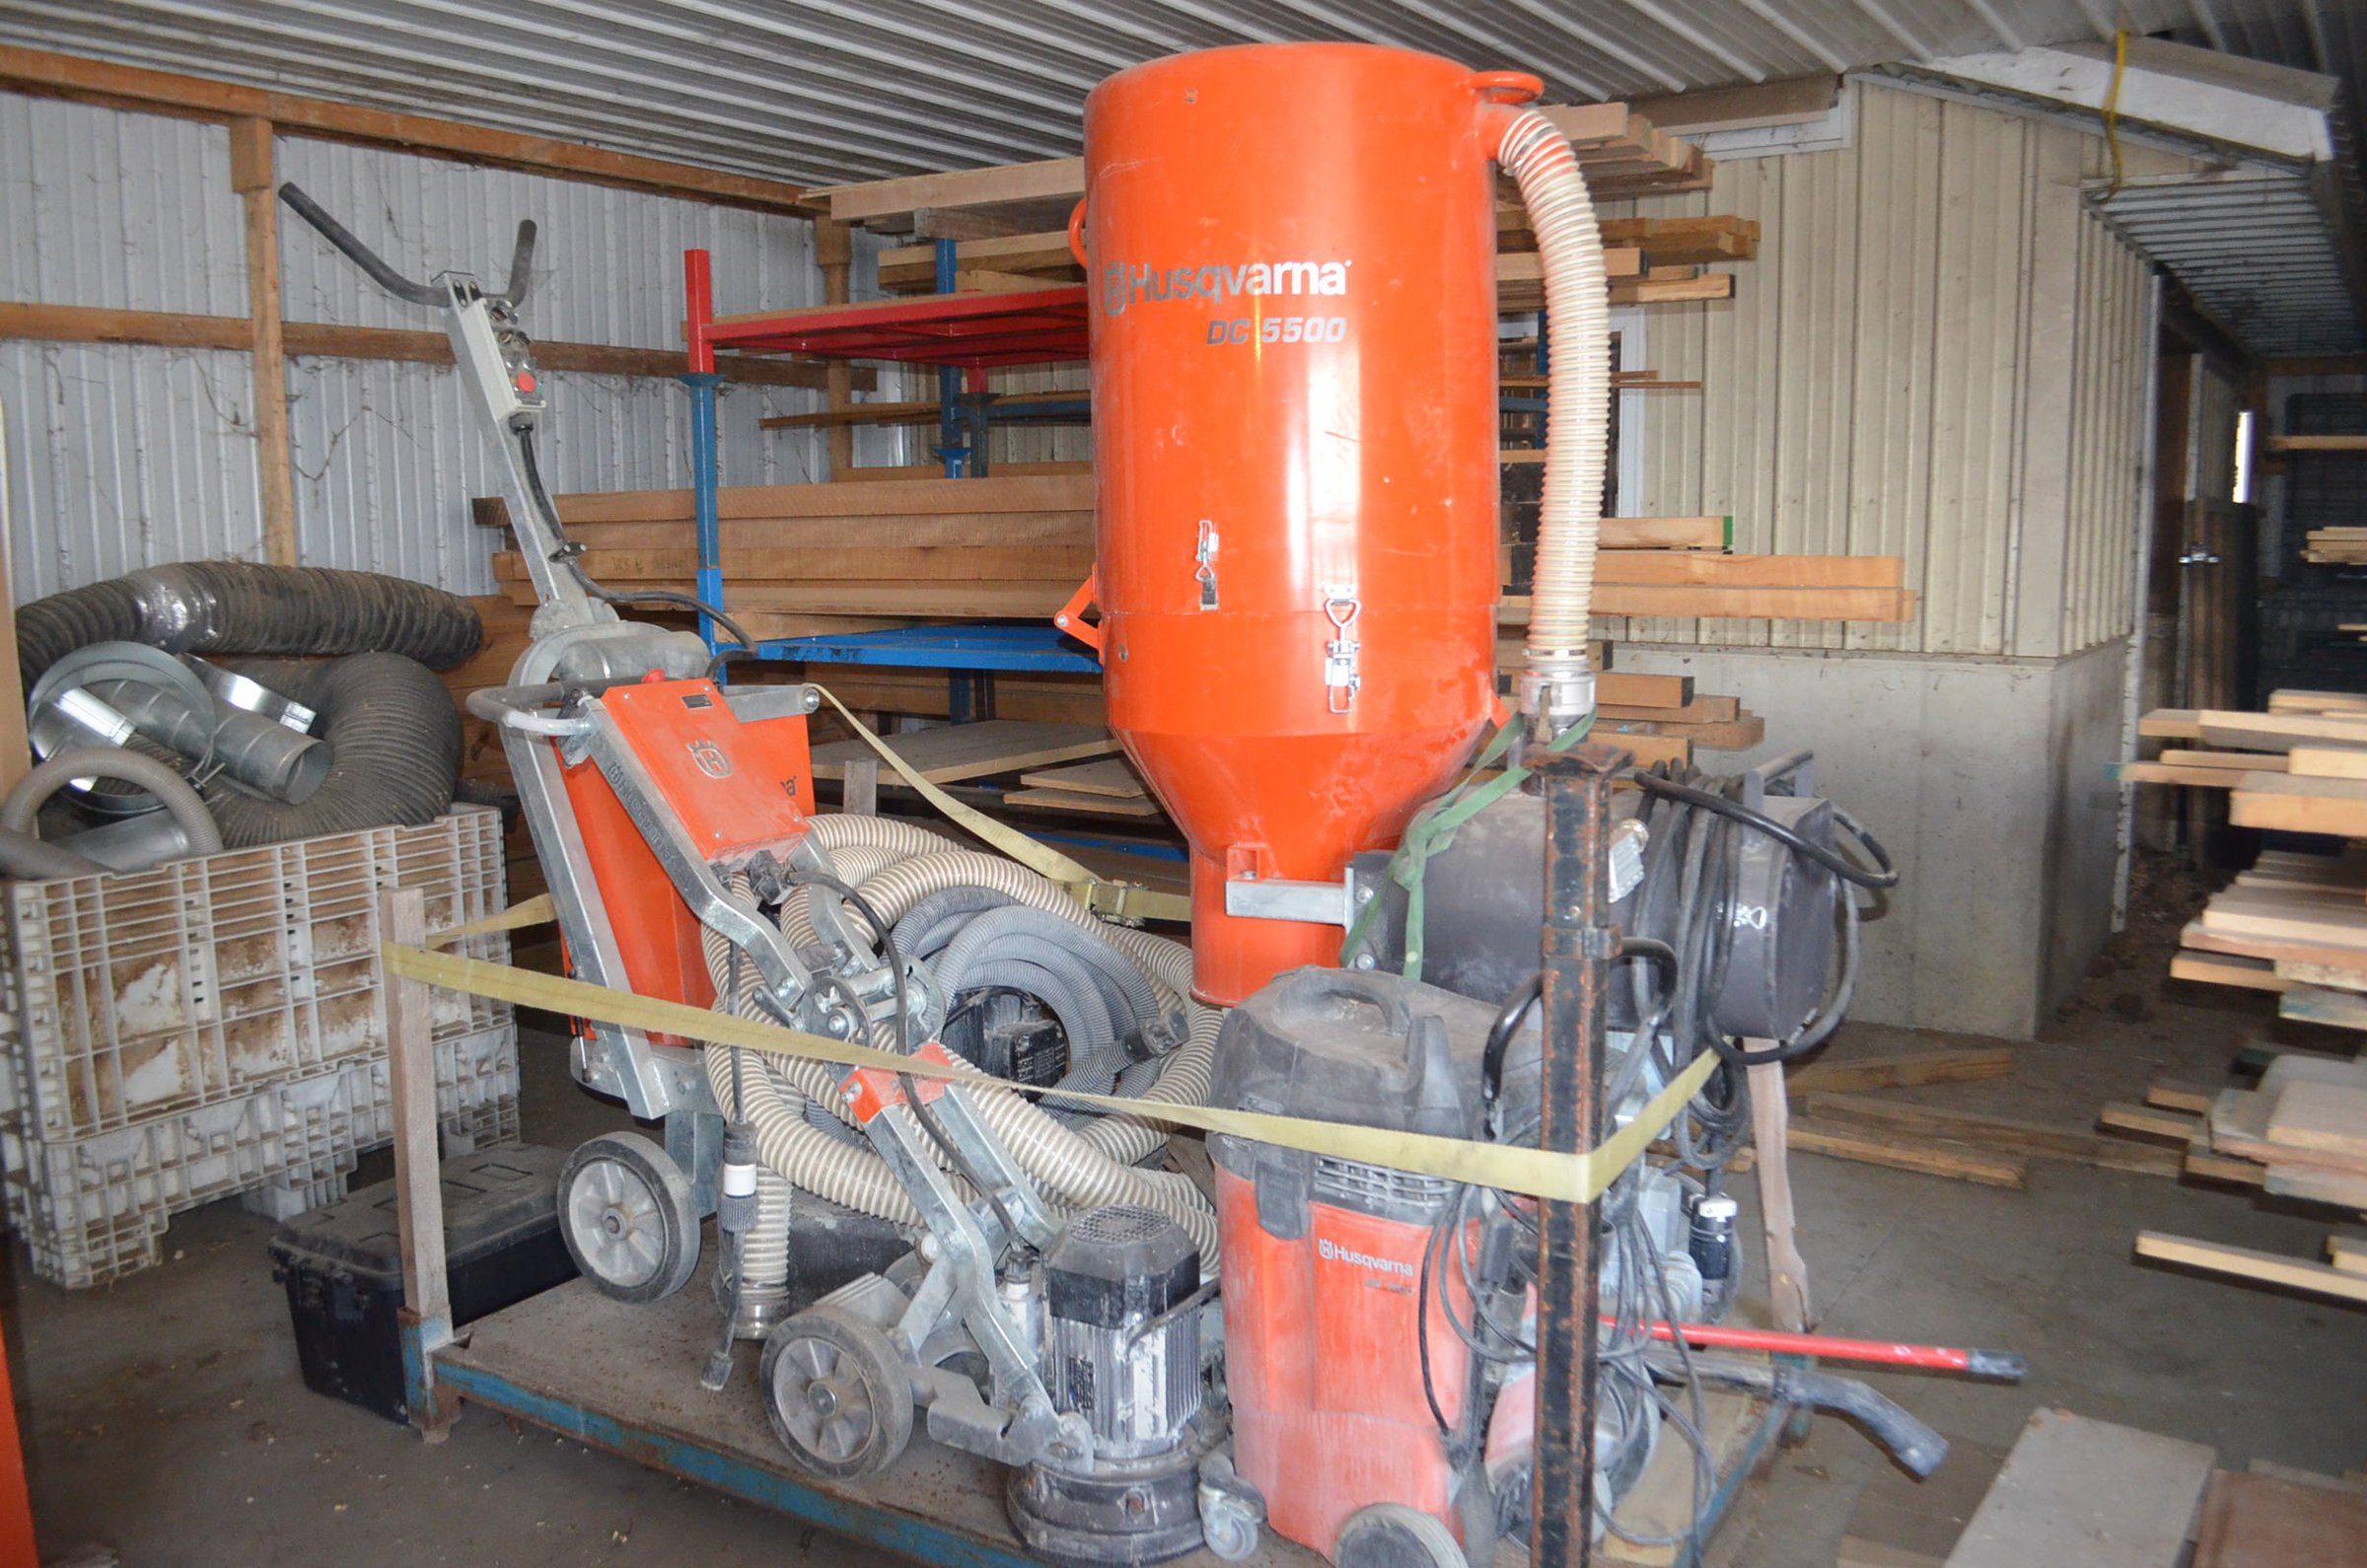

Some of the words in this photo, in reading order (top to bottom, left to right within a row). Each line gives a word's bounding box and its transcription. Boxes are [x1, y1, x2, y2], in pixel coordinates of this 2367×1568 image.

[1129, 259, 1347, 305] Husqvarna
[1206, 319, 1251, 345] DC
[1261, 317, 1347, 343] 5500
[1334, 1245, 1413, 1277] Husqvarna
